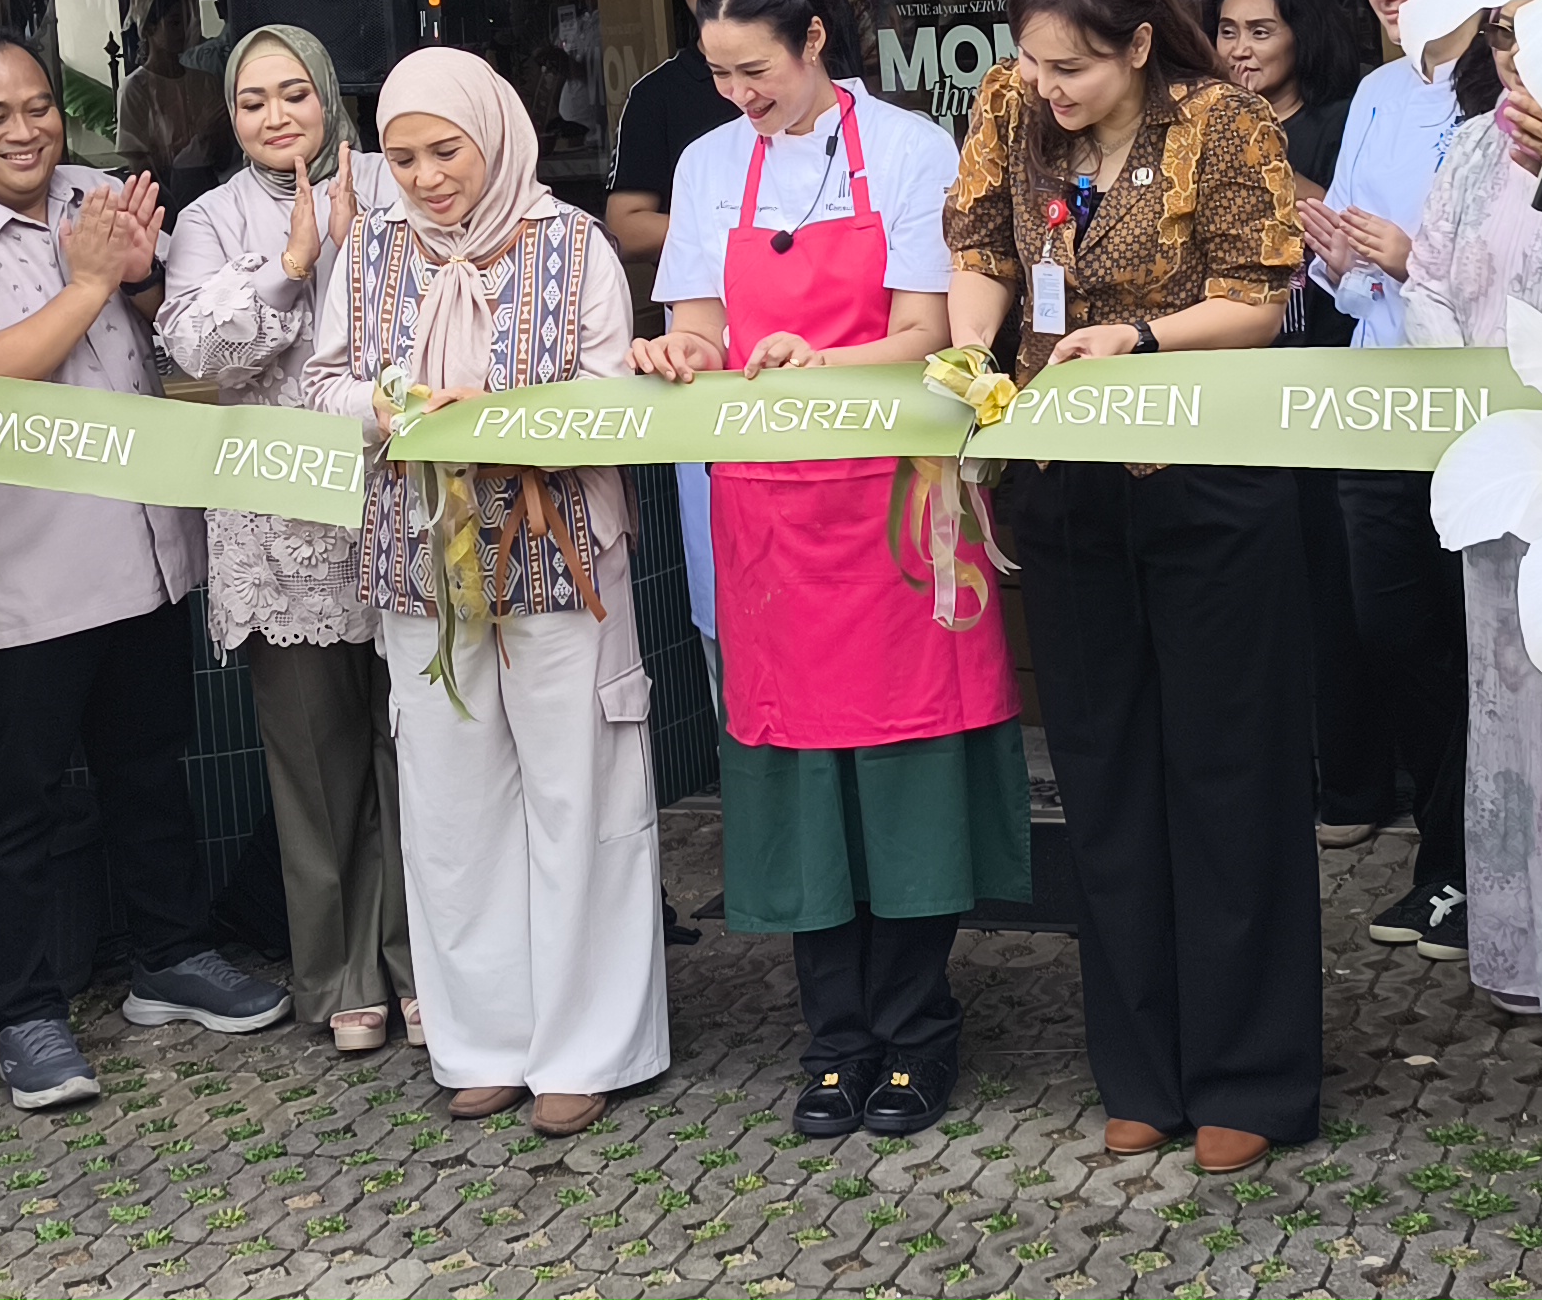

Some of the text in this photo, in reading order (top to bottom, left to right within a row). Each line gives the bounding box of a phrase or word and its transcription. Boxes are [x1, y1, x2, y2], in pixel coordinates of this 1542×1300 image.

[942, 3, 968, 18] your
[968, 0, 1009, 14] SERVIC
[931, 76, 977, 117] thr
[472, 398, 901, 440] PASREN PASREN
[1004, 384, 1489, 432] PASREN PASREN
